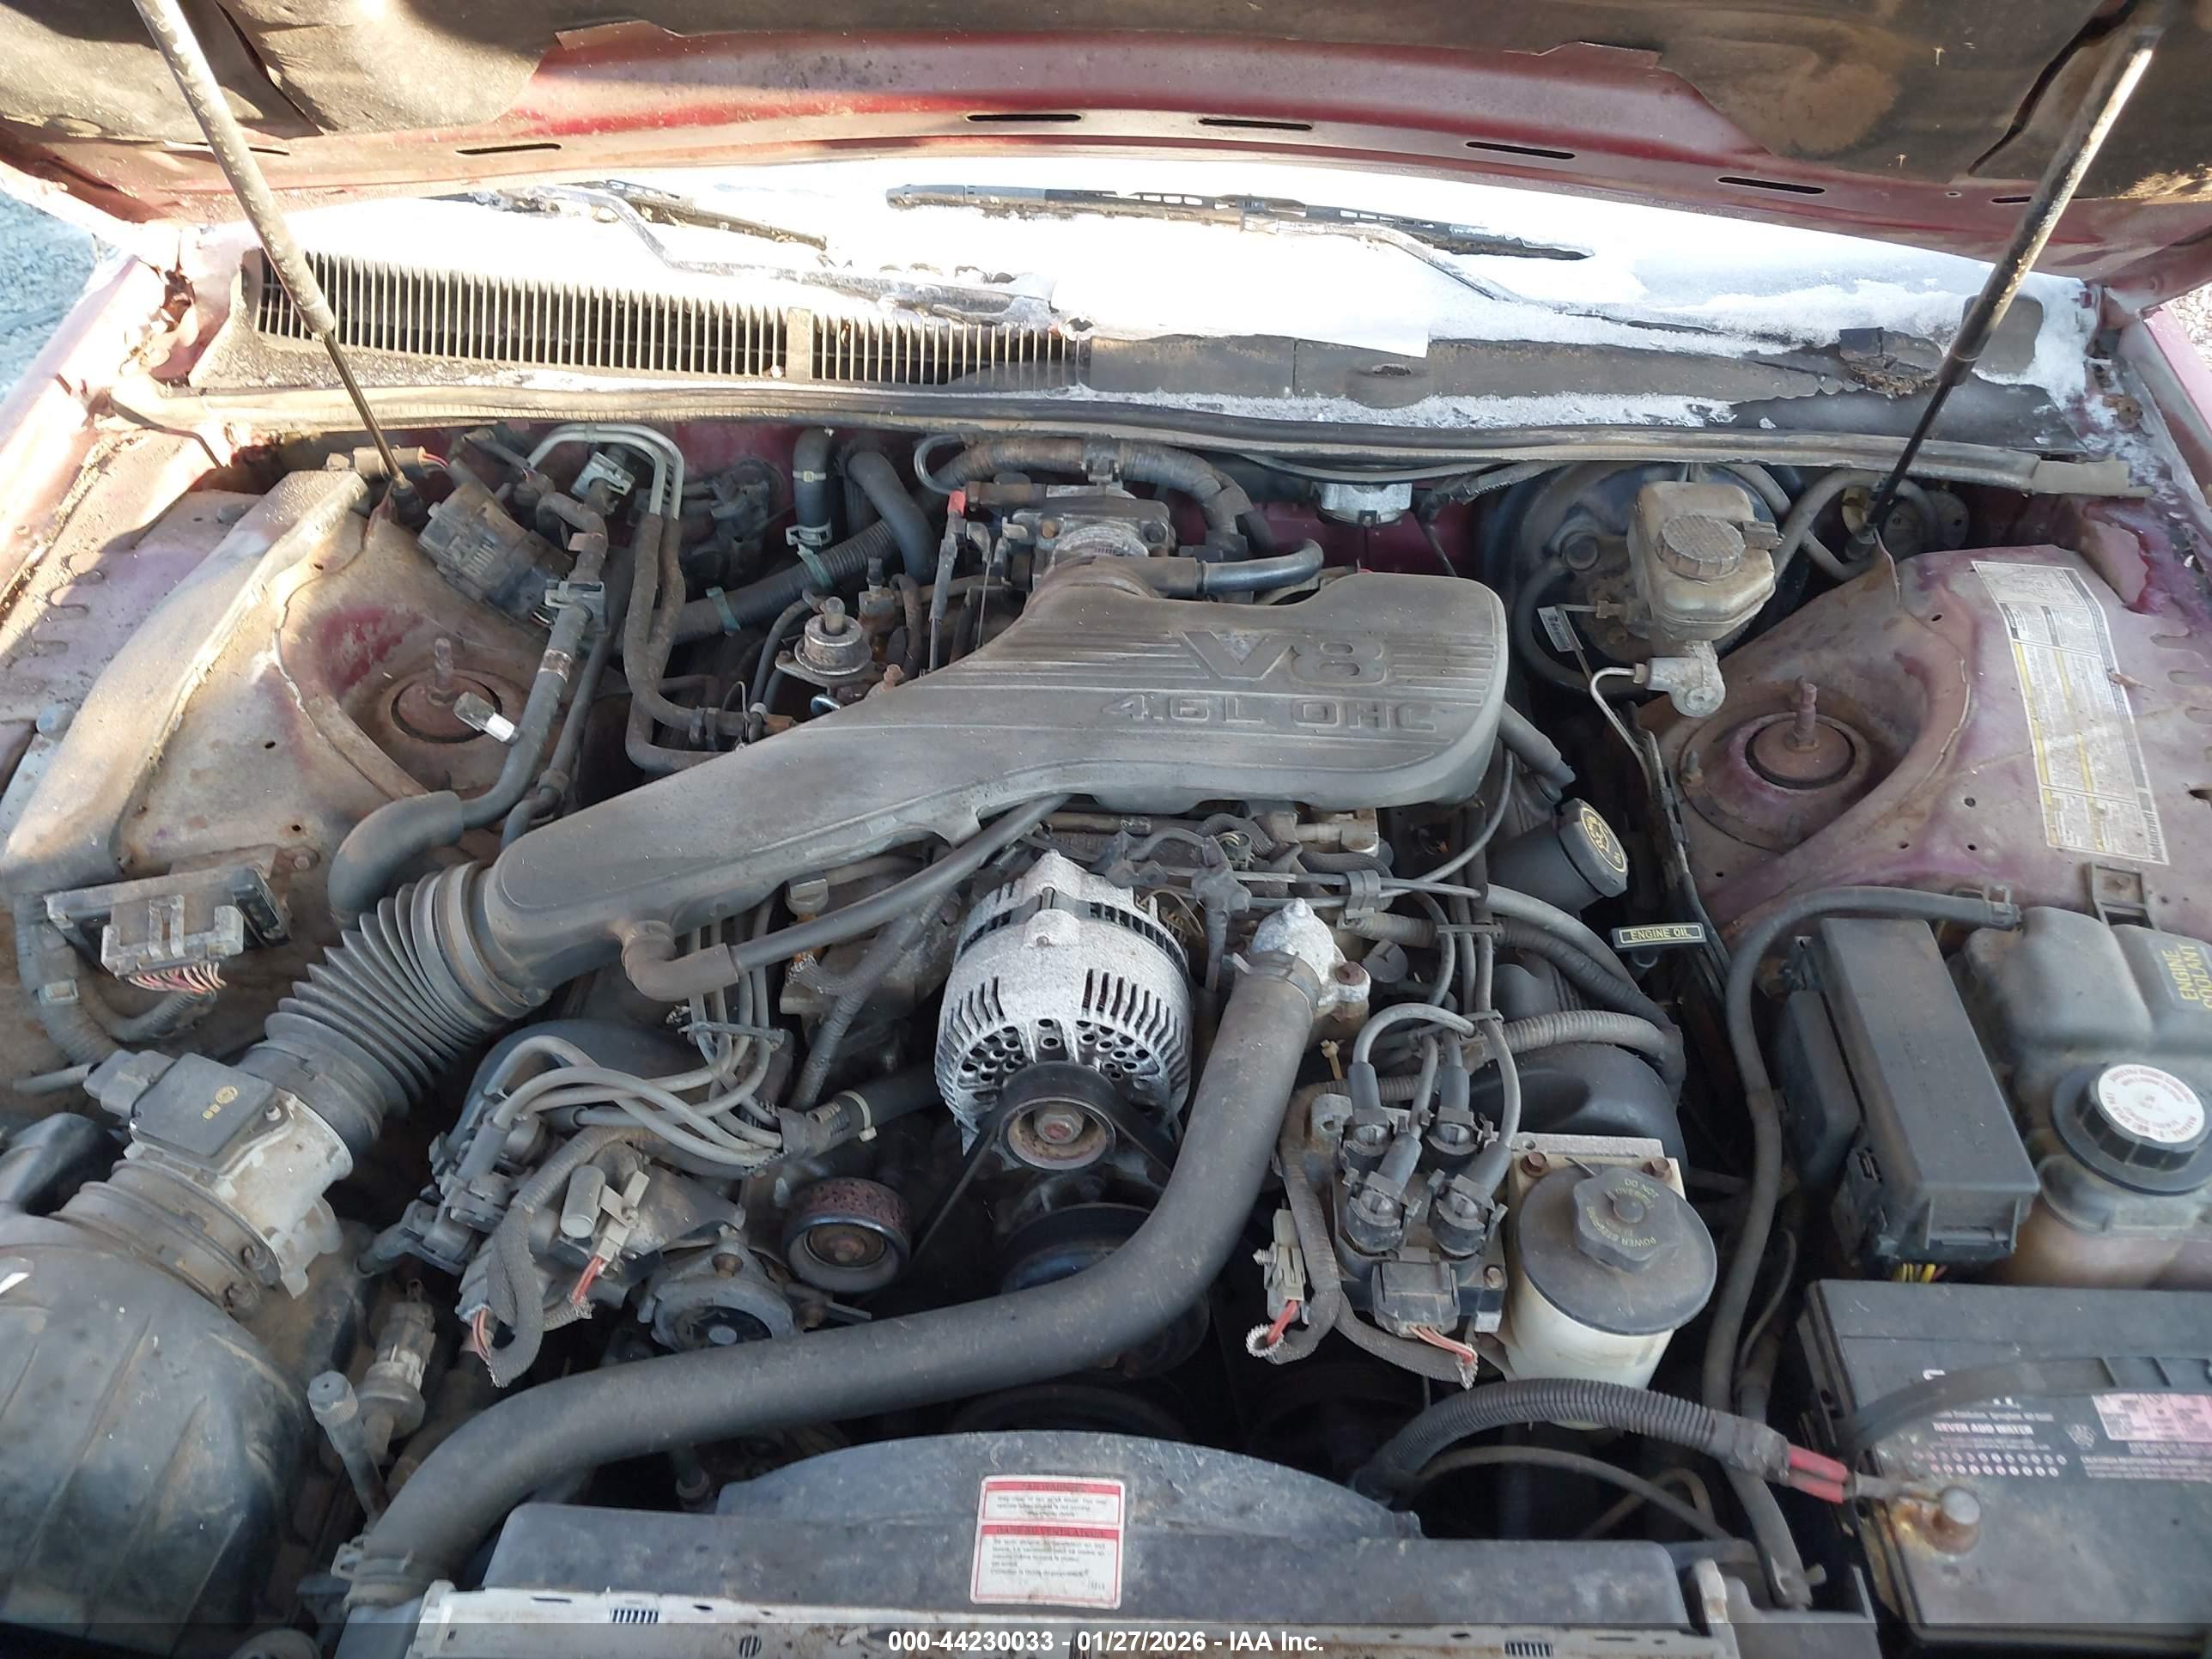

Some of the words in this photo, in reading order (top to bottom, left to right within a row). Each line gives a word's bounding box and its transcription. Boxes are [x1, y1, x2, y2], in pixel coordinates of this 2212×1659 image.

[1181, 630, 1388, 689] V8
[1291, 700, 1437, 732] OHC
[1631, 928, 1670, 940] ENGINE
[1673, 927, 1691, 937] OIL
[2161, 948, 2199, 1000] ENGINE
[2178, 944, 2212, 1009] COOLANT
[1624, 1177, 1638, 1188] DO
[1642, 1184, 1660, 1199] NOT
[1621, 1236, 1656, 1248] POWER
[1932, 1421, 1970, 1433] NEVER
[1971, 1423, 1996, 1435] ADD
[1995, 1424, 2034, 1436] WATER
